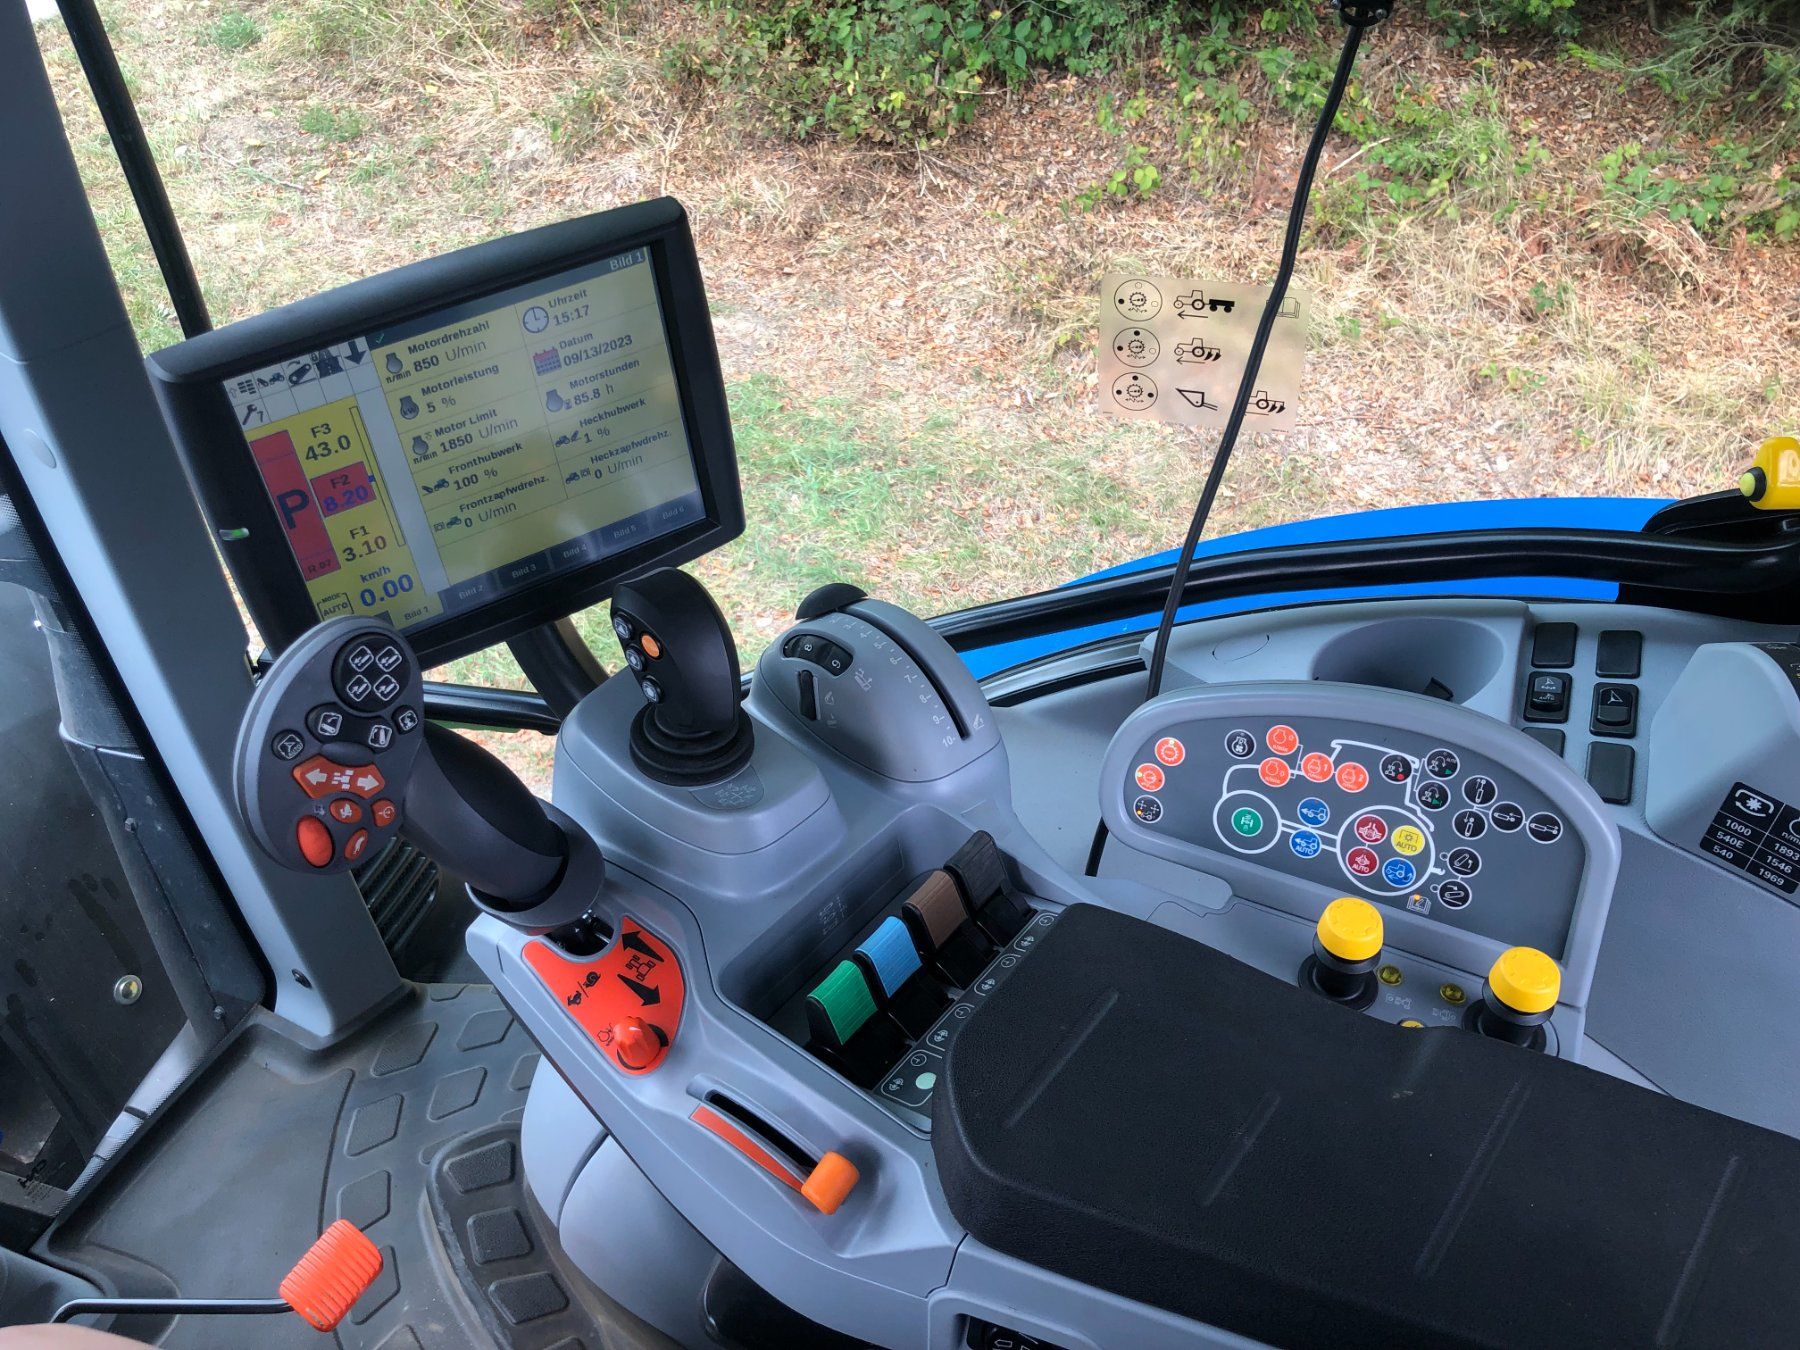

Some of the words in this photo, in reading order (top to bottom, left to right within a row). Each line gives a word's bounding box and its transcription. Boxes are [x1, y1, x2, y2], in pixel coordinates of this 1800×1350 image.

[610, 255, 633, 271] Bild
[635, 252, 644, 264] 1
[548, 289, 588, 309] Uhrzeit
[553, 304, 590, 326] 15:17
[408, 321, 490, 355] Motordrehzahl
[559, 332, 594, 350] Datum
[413, 355, 440, 372] 850
[445, 340, 488, 361] U/min
[563, 334, 633, 367] 09/13/2023
[421, 363, 500, 396] Motorleistung
[569, 359, 640, 390] Motorstunden
[426, 402, 436, 413] 5
[440, 395, 456, 408] %
[574, 388, 601, 406] 85.8
[605, 383, 615, 395] h
[434, 420, 467, 437] Motor
[469, 408, 498, 426] Limit
[579, 398, 647, 428] Heckhubwerk
[310, 423, 332, 438] F3
[440, 433, 473, 454] 1850
[478, 419, 518, 439] U/min
[584, 432, 592, 444] 1
[597, 427, 610, 438] %
[304, 434, 351, 462] 43.0
[448, 442, 523, 474] Fronthubwerk
[594, 468, 603, 479] 0
[607, 455, 643, 474] U/min
[330, 474, 351, 490] F2
[453, 473, 479, 491] 100
[483, 466, 498, 479] %
[322, 484, 369, 513] 8.20
[276, 488, 310, 530] P
[464, 516, 473, 528] 0
[478, 501, 518, 523] U/min
[349, 525, 370, 541] F1
[613, 526, 631, 538] Bild
[342, 535, 388, 563] 3.10
[563, 547, 581, 559] Bild
[360, 565, 391, 584] km/h
[512, 567, 530, 579] Bild
[530, 564, 537, 572] 3
[359, 573, 414, 607] 0.00
[458, 587, 477, 600] Bild
[323, 602, 349, 617] AUTO
[889, 656, 898, 665] 6
[903, 674, 913, 684] 7
[918, 694, 928, 704] 8
[932, 715, 940, 725] 9
[941, 735, 954, 747] 10
[1725, 819, 1752, 837] 1000
[1396, 841, 1418, 852] AUTO
[1716, 831, 1745, 849] 540E
[1295, 845, 1314, 855] AUTO
[1712, 845, 1734, 859] 540
[1774, 842, 1800, 861] 1893
[1352, 863, 1369, 873] AUTO
[1766, 855, 1793, 874] 1546
[1758, 868, 1785, 886] 1969
